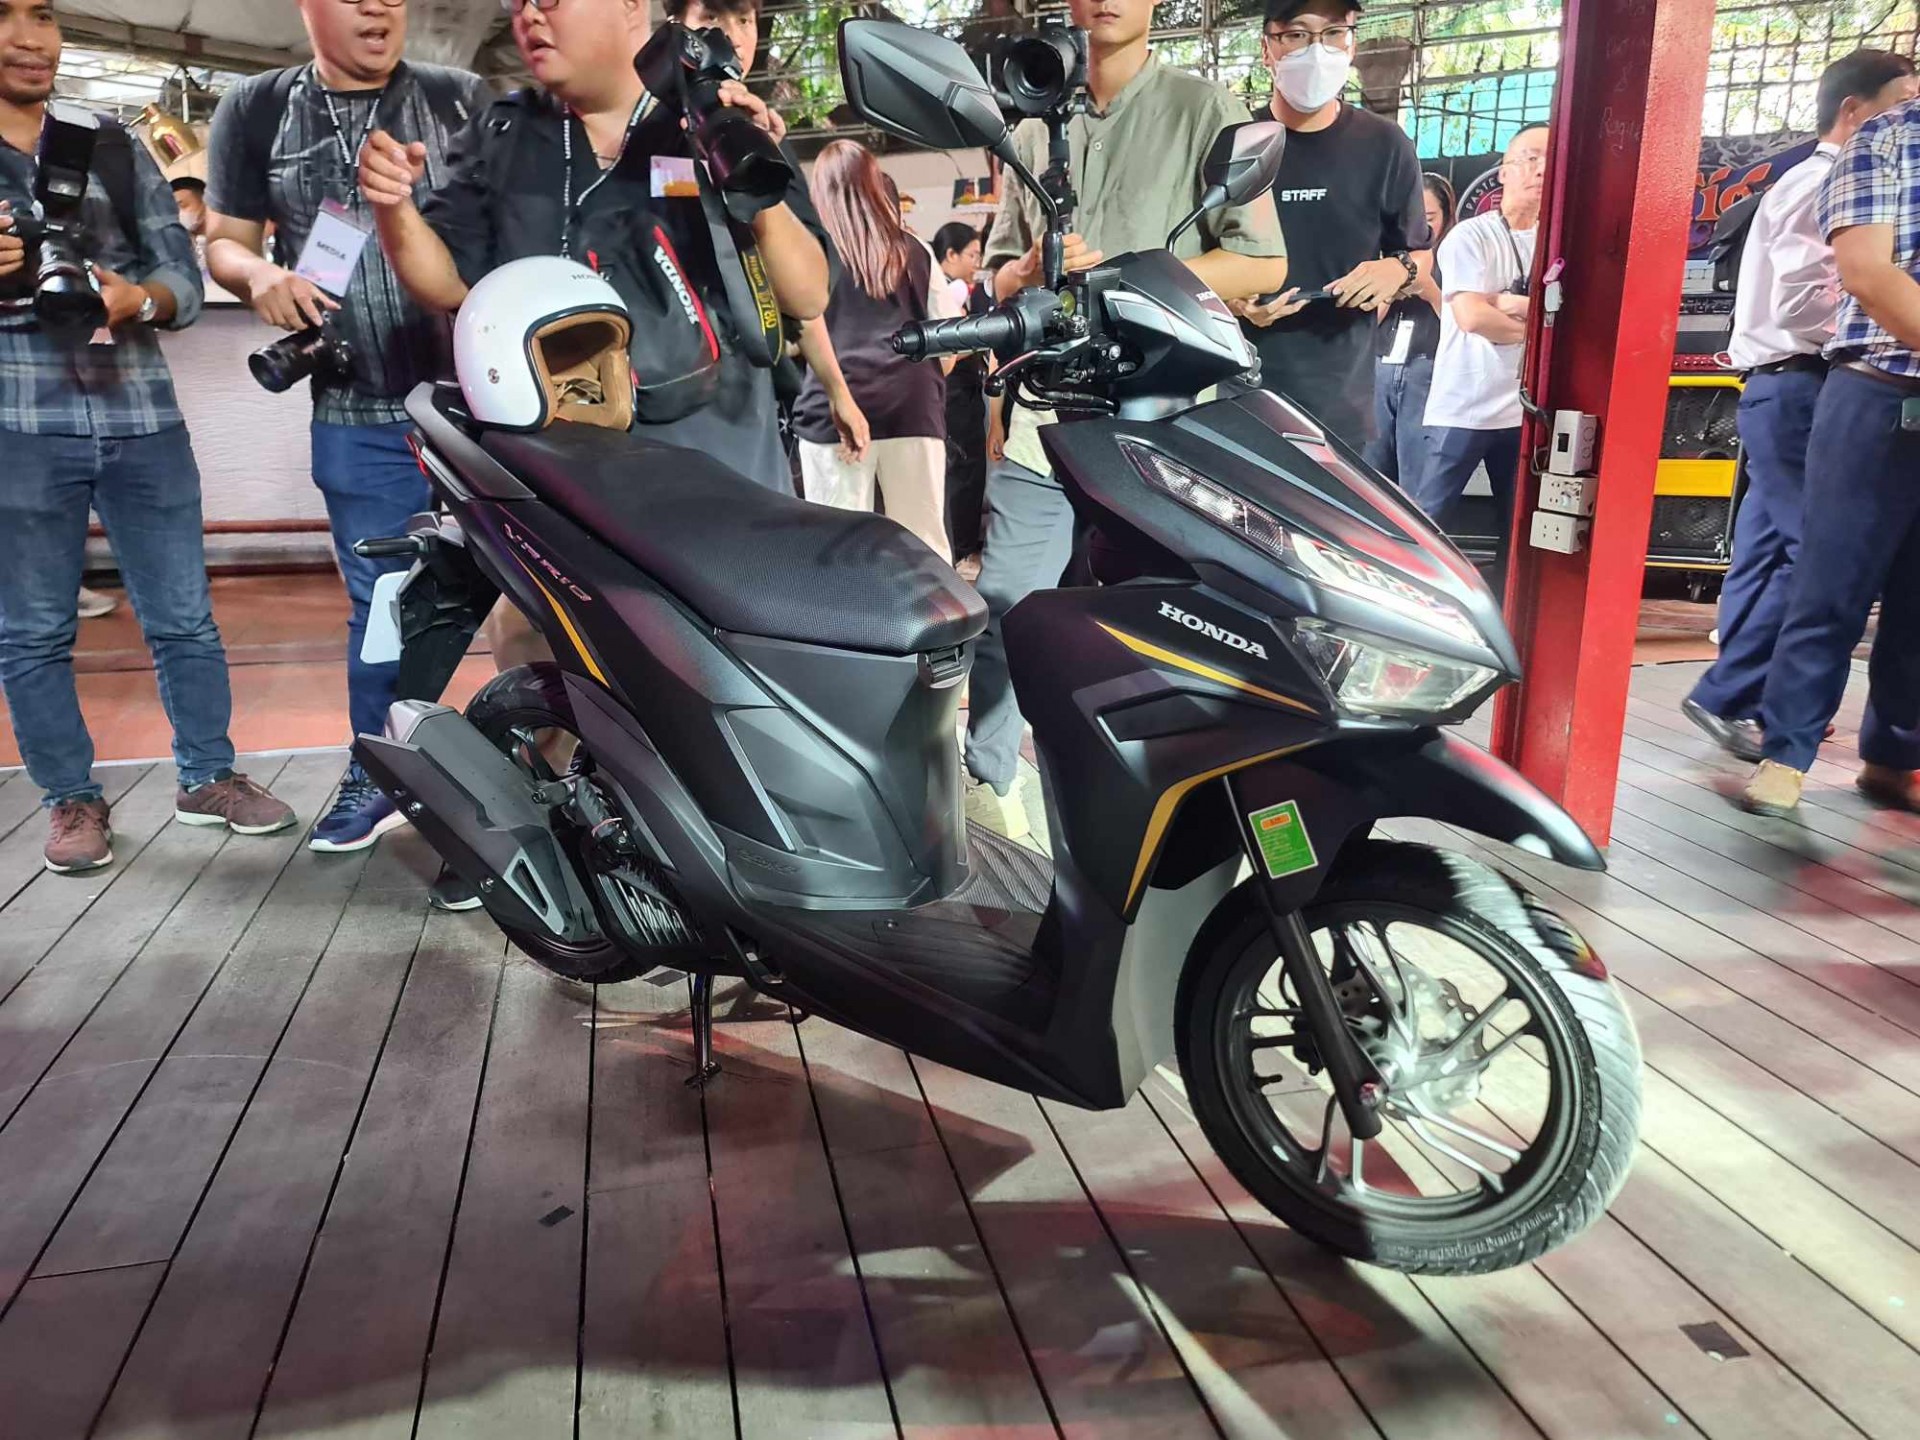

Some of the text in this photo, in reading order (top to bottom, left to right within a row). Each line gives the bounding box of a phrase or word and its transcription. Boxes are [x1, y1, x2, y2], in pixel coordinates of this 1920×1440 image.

[1281, 188, 1328, 201] STAFF
[1465, 177, 1498, 211] PASTE
[653, 245, 701, 326] HONDA
[504, 523, 593, 602] VARIO
[1157, 600, 1270, 661] HONDA
